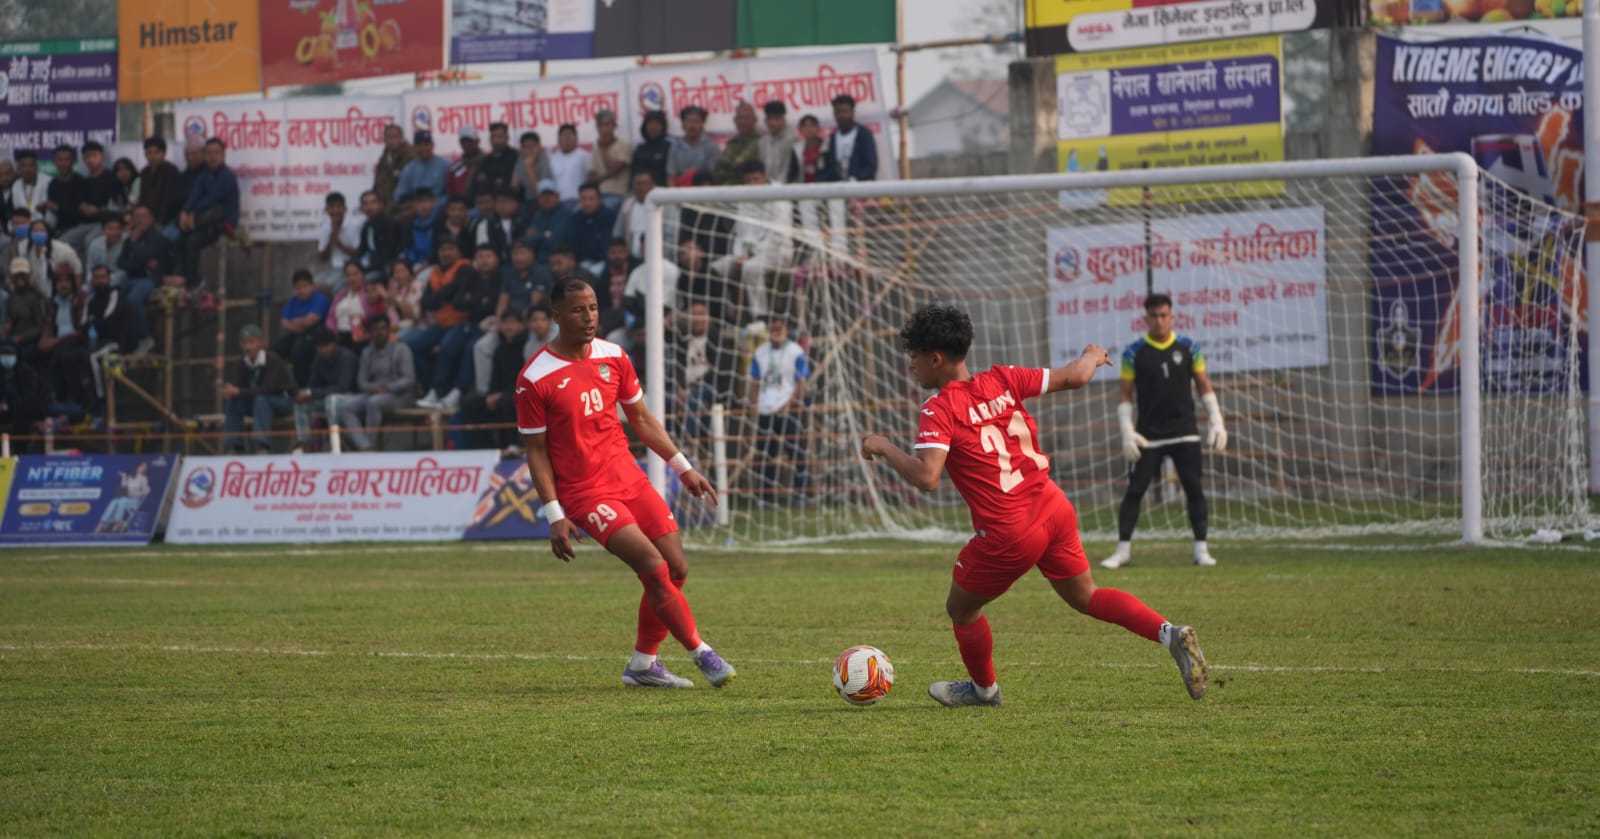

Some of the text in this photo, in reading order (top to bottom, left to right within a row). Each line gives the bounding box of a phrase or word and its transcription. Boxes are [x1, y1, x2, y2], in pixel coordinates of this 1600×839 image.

[139, 20, 238, 49] Himstar
[1112, 60, 1273, 100] नेपाल खानेपानी संस्थान
[1392, 45, 1481, 82] XTREME
[1483, 45, 1571, 85] ENERGY
[1160, 361, 1170, 379] 1
[580, 388, 604, 417] 29
[968, 390, 1016, 424] ARMY
[980, 410, 1050, 494] 21
[27, 465, 104, 481] NT FIBER
[219, 456, 484, 499] बिर्तामोड नगरपालिका
[587, 503, 618, 533] 29
